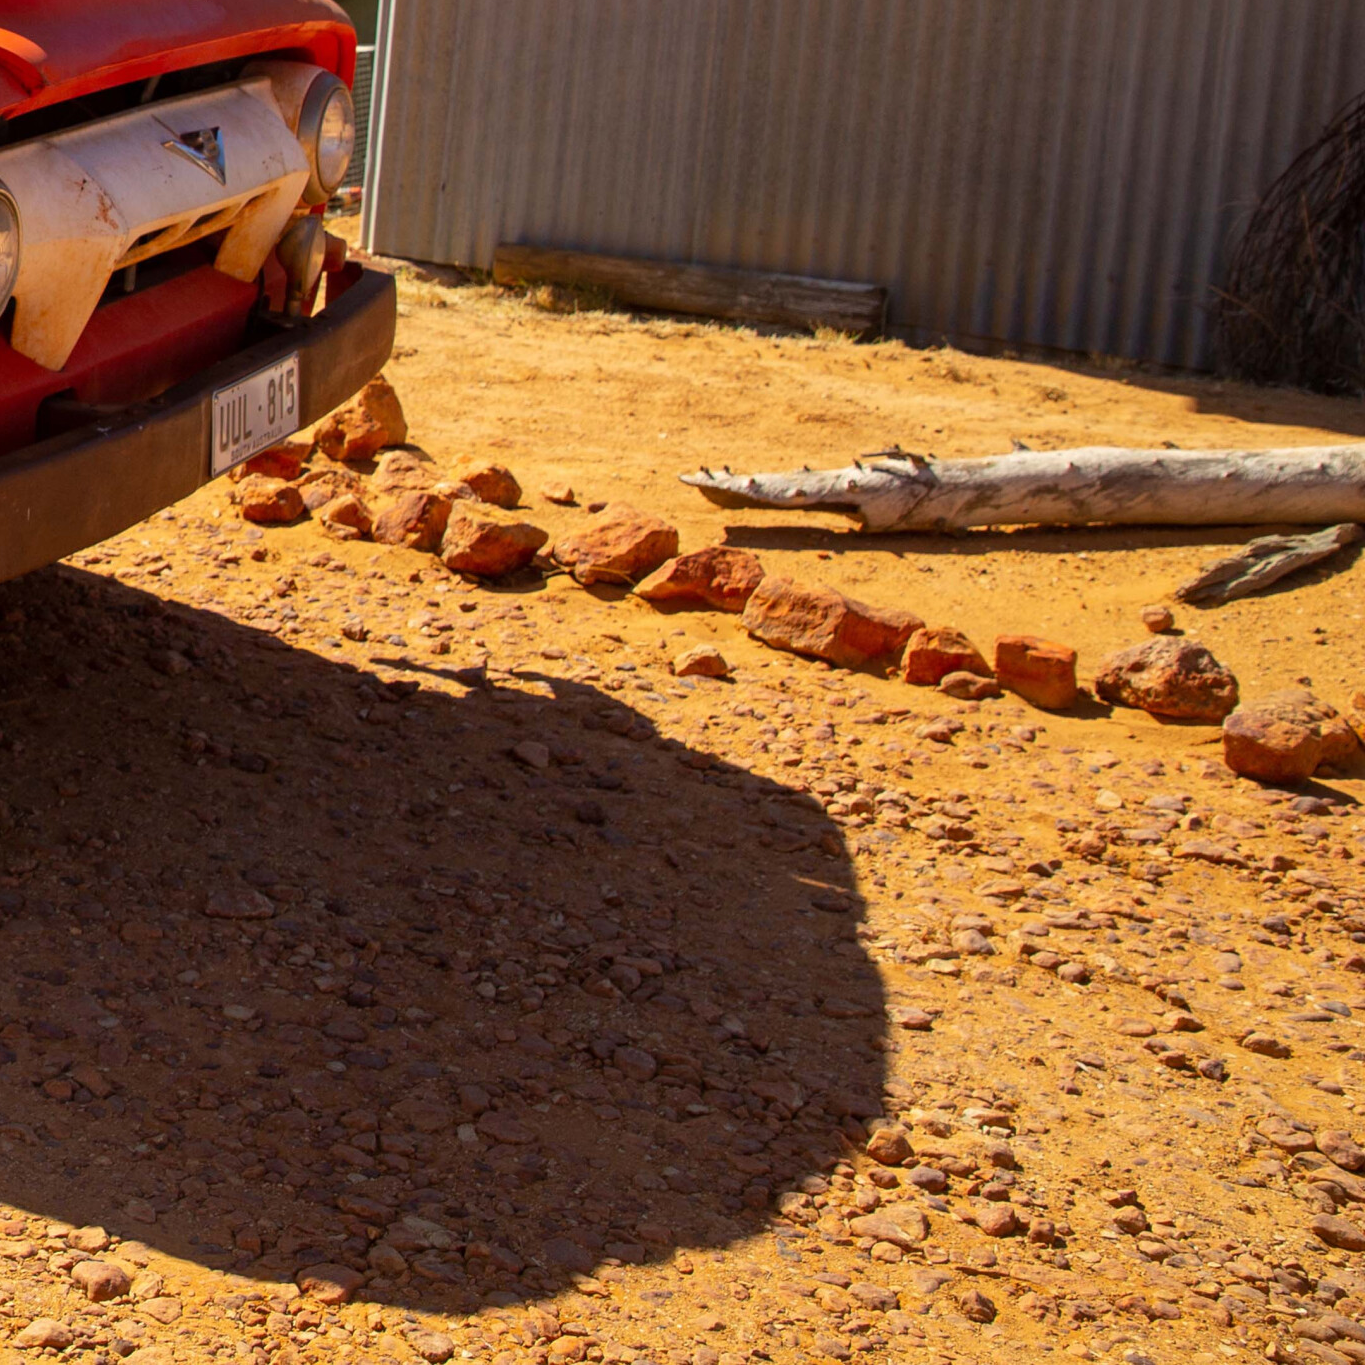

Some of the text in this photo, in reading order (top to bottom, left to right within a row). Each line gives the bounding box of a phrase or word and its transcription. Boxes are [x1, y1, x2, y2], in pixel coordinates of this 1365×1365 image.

[219, 367, 295, 453] UUL 815
[231, 425, 284, 463] SOUTH AUSTRALIA
